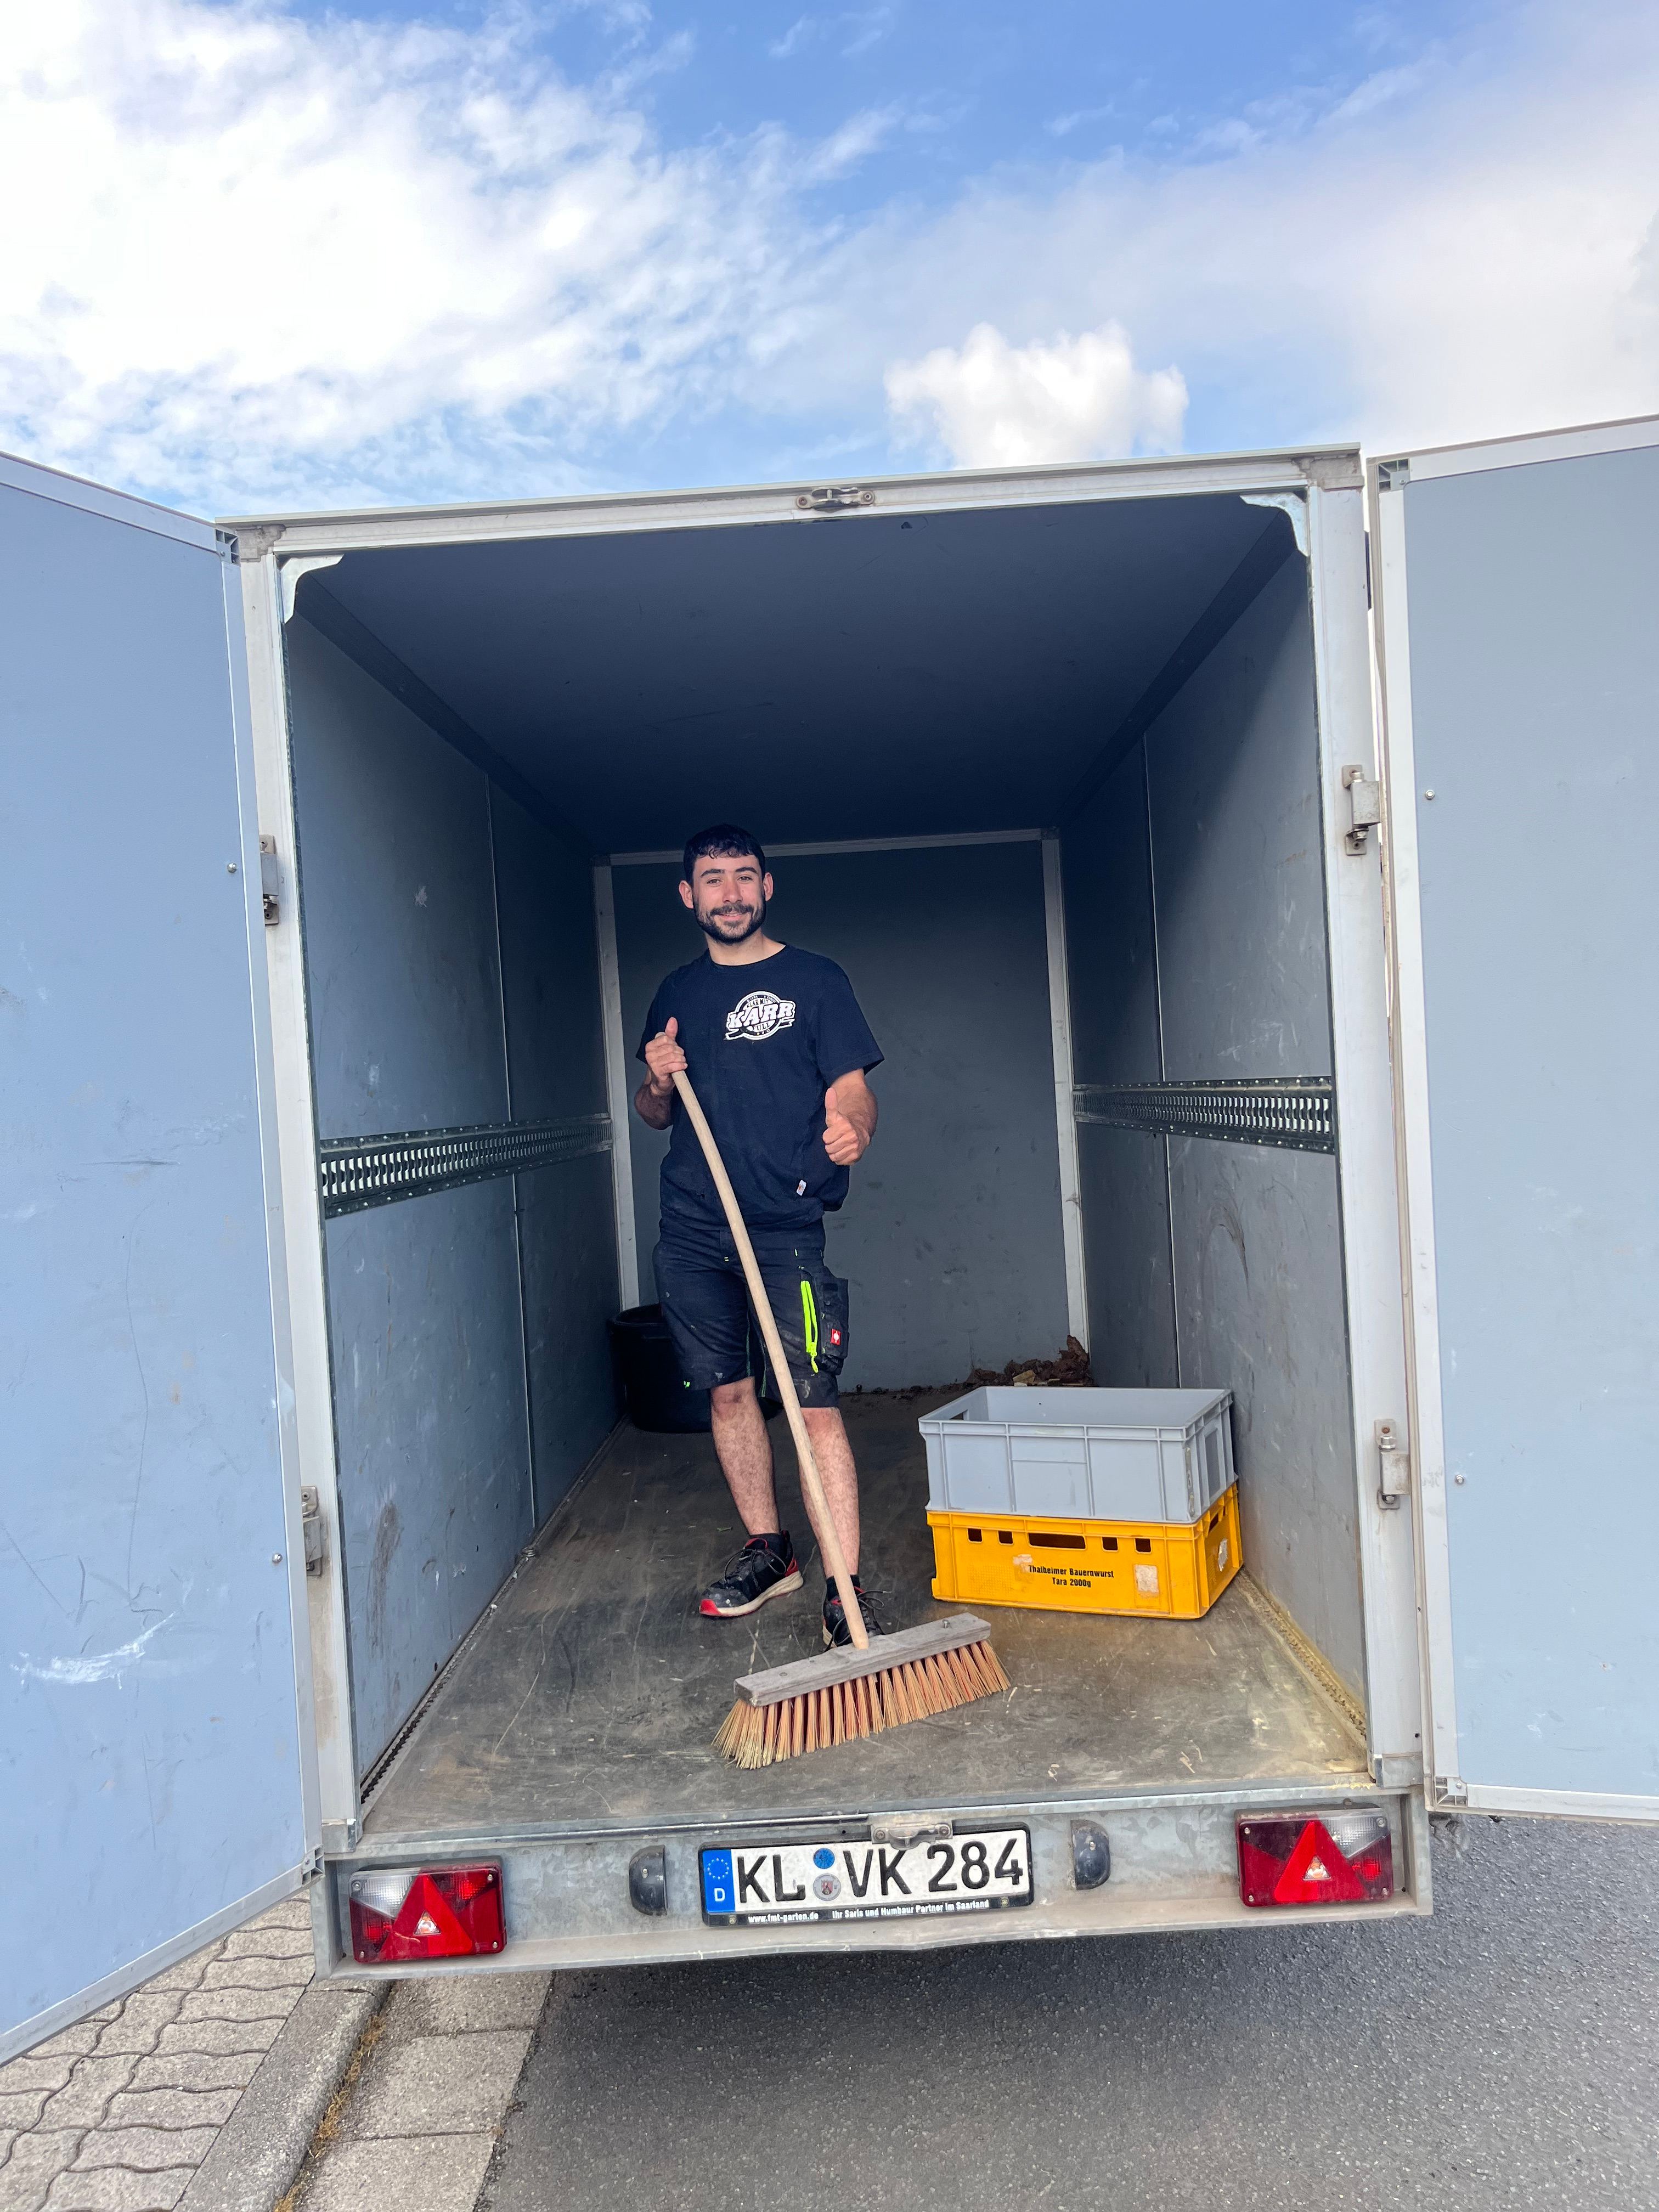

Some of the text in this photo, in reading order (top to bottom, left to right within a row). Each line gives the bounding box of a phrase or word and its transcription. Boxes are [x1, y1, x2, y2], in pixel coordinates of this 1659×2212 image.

[728, 1002, 793, 1029] KARR
[1028, 1565, 1114, 1578] Thalheimer Bauernwurst
[1052, 1577, 1091, 1588] Tara 2000g
[737, 1854, 806, 1903] KL
[843, 1848, 912, 1898] VK
[927, 1838, 1024, 1893] 284
[714, 1888, 726, 1902] D
[832, 1910, 843, 1919] Ihr
[865, 1908, 879, 1917] und
[881, 1906, 914, 1916] Humbaur
[916, 1904, 944, 1914] Partner
[945, 1902, 955, 1911] im
[956, 1899, 990, 1910] Saarland
[748, 1912, 819, 1923] www.fmt-garten.de
